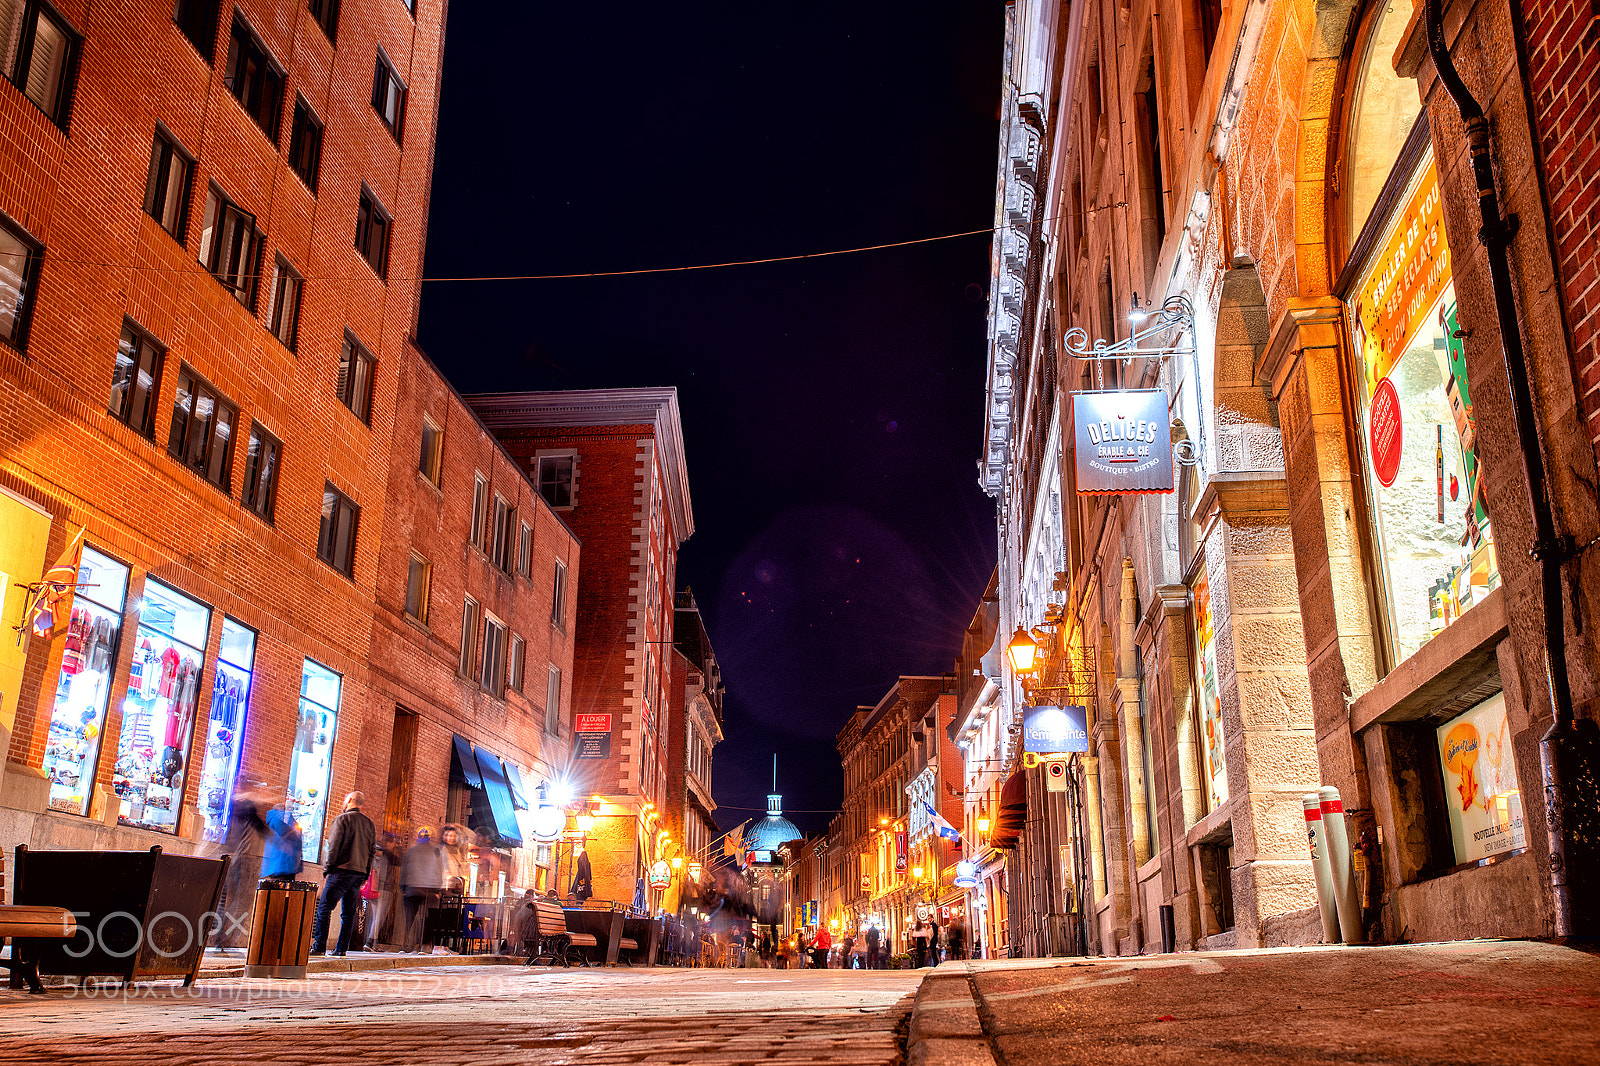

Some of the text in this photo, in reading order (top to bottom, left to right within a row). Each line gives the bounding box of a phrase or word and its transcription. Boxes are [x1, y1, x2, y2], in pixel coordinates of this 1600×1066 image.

[1373, 242, 1406, 308] BRILLER
[1407, 217, 1419, 249] DE
[1387, 225, 1438, 319] SES ÉCLATS
[1387, 249, 1447, 354] GLOW YOUR MIND
[1089, 457, 1160, 475] BOUTIQUE BISTRO
[1098, 445, 1149, 458] ÉRABLE & CIE
[1473, 826, 1495, 842] NOUVELLE
[1495, 821, 1510, 836] IMAGE
